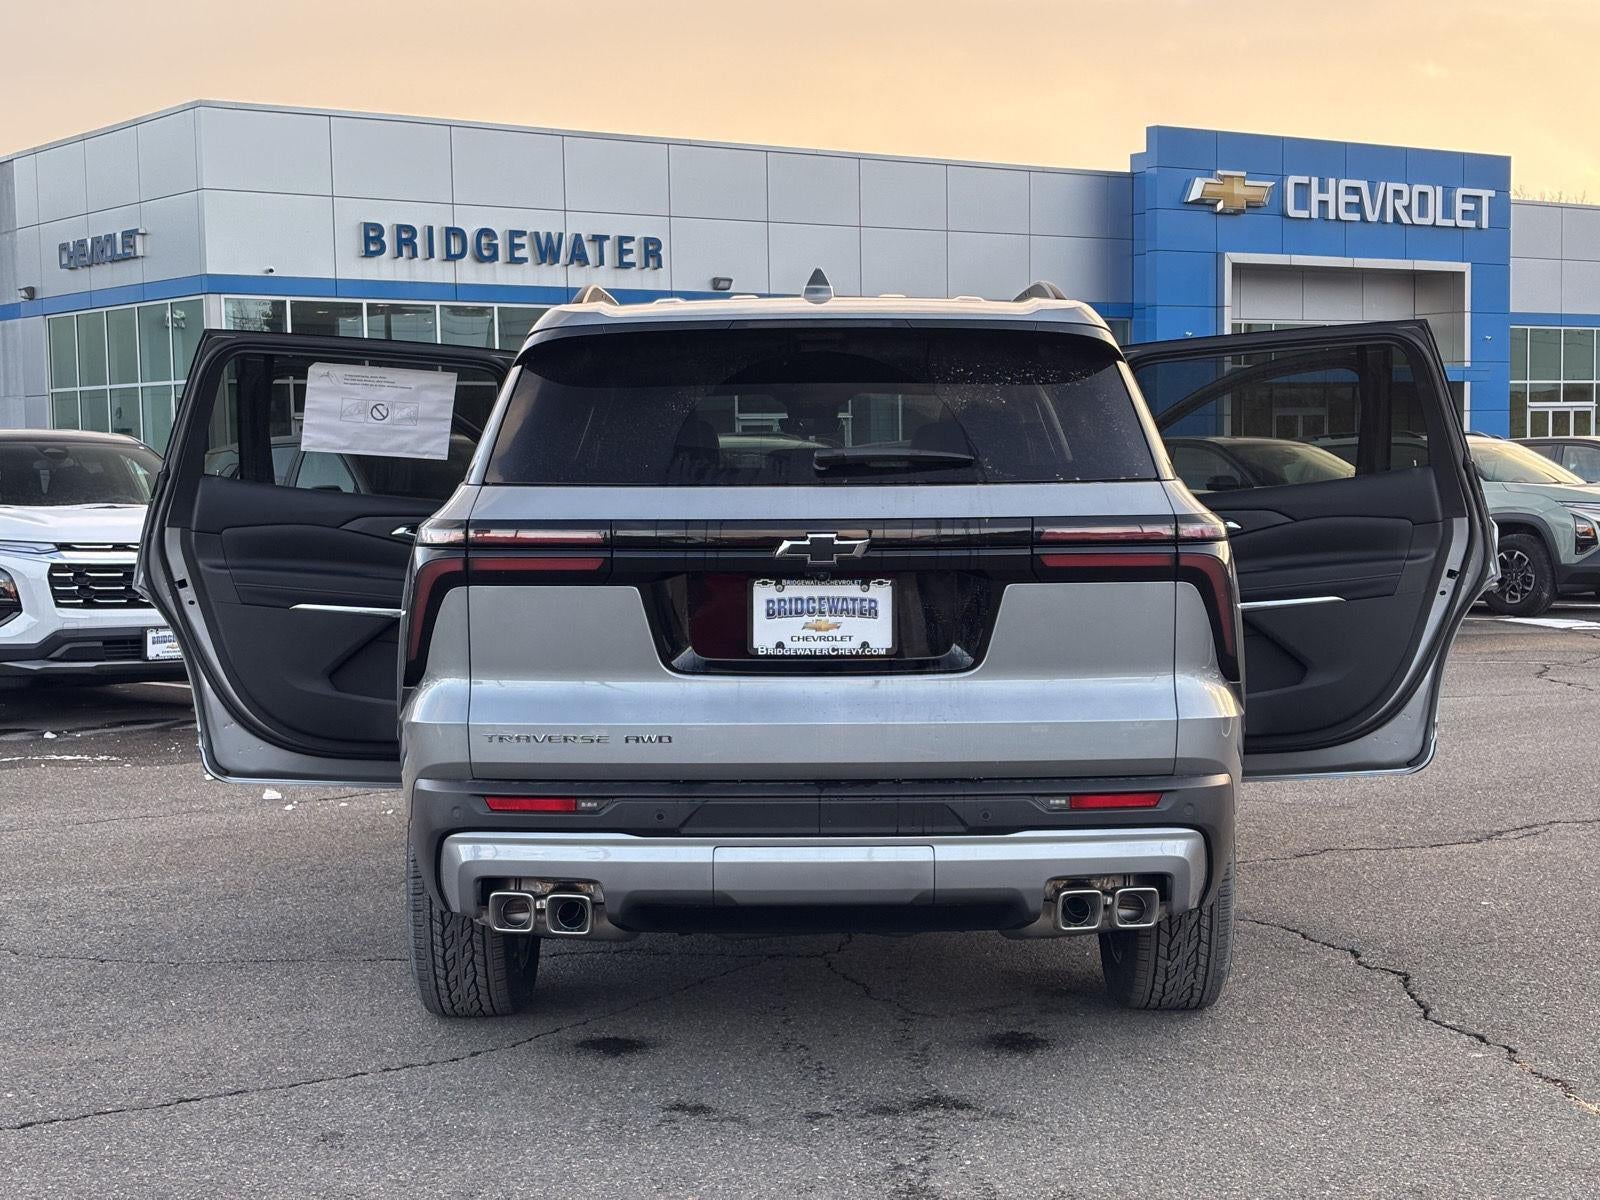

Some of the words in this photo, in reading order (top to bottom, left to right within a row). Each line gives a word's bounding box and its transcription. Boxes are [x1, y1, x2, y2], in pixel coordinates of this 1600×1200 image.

[1287, 175, 1496, 229] CHEVROLET
[59, 228, 146, 269] CHEVROLET
[360, 221, 664, 270] BRIDGEWATER
[765, 596, 879, 619] BRIDGEWATER
[790, 635, 854, 643] CHEVROLET
[484, 733, 610, 744] TRAVERSE
[624, 733, 673, 744] AWD
